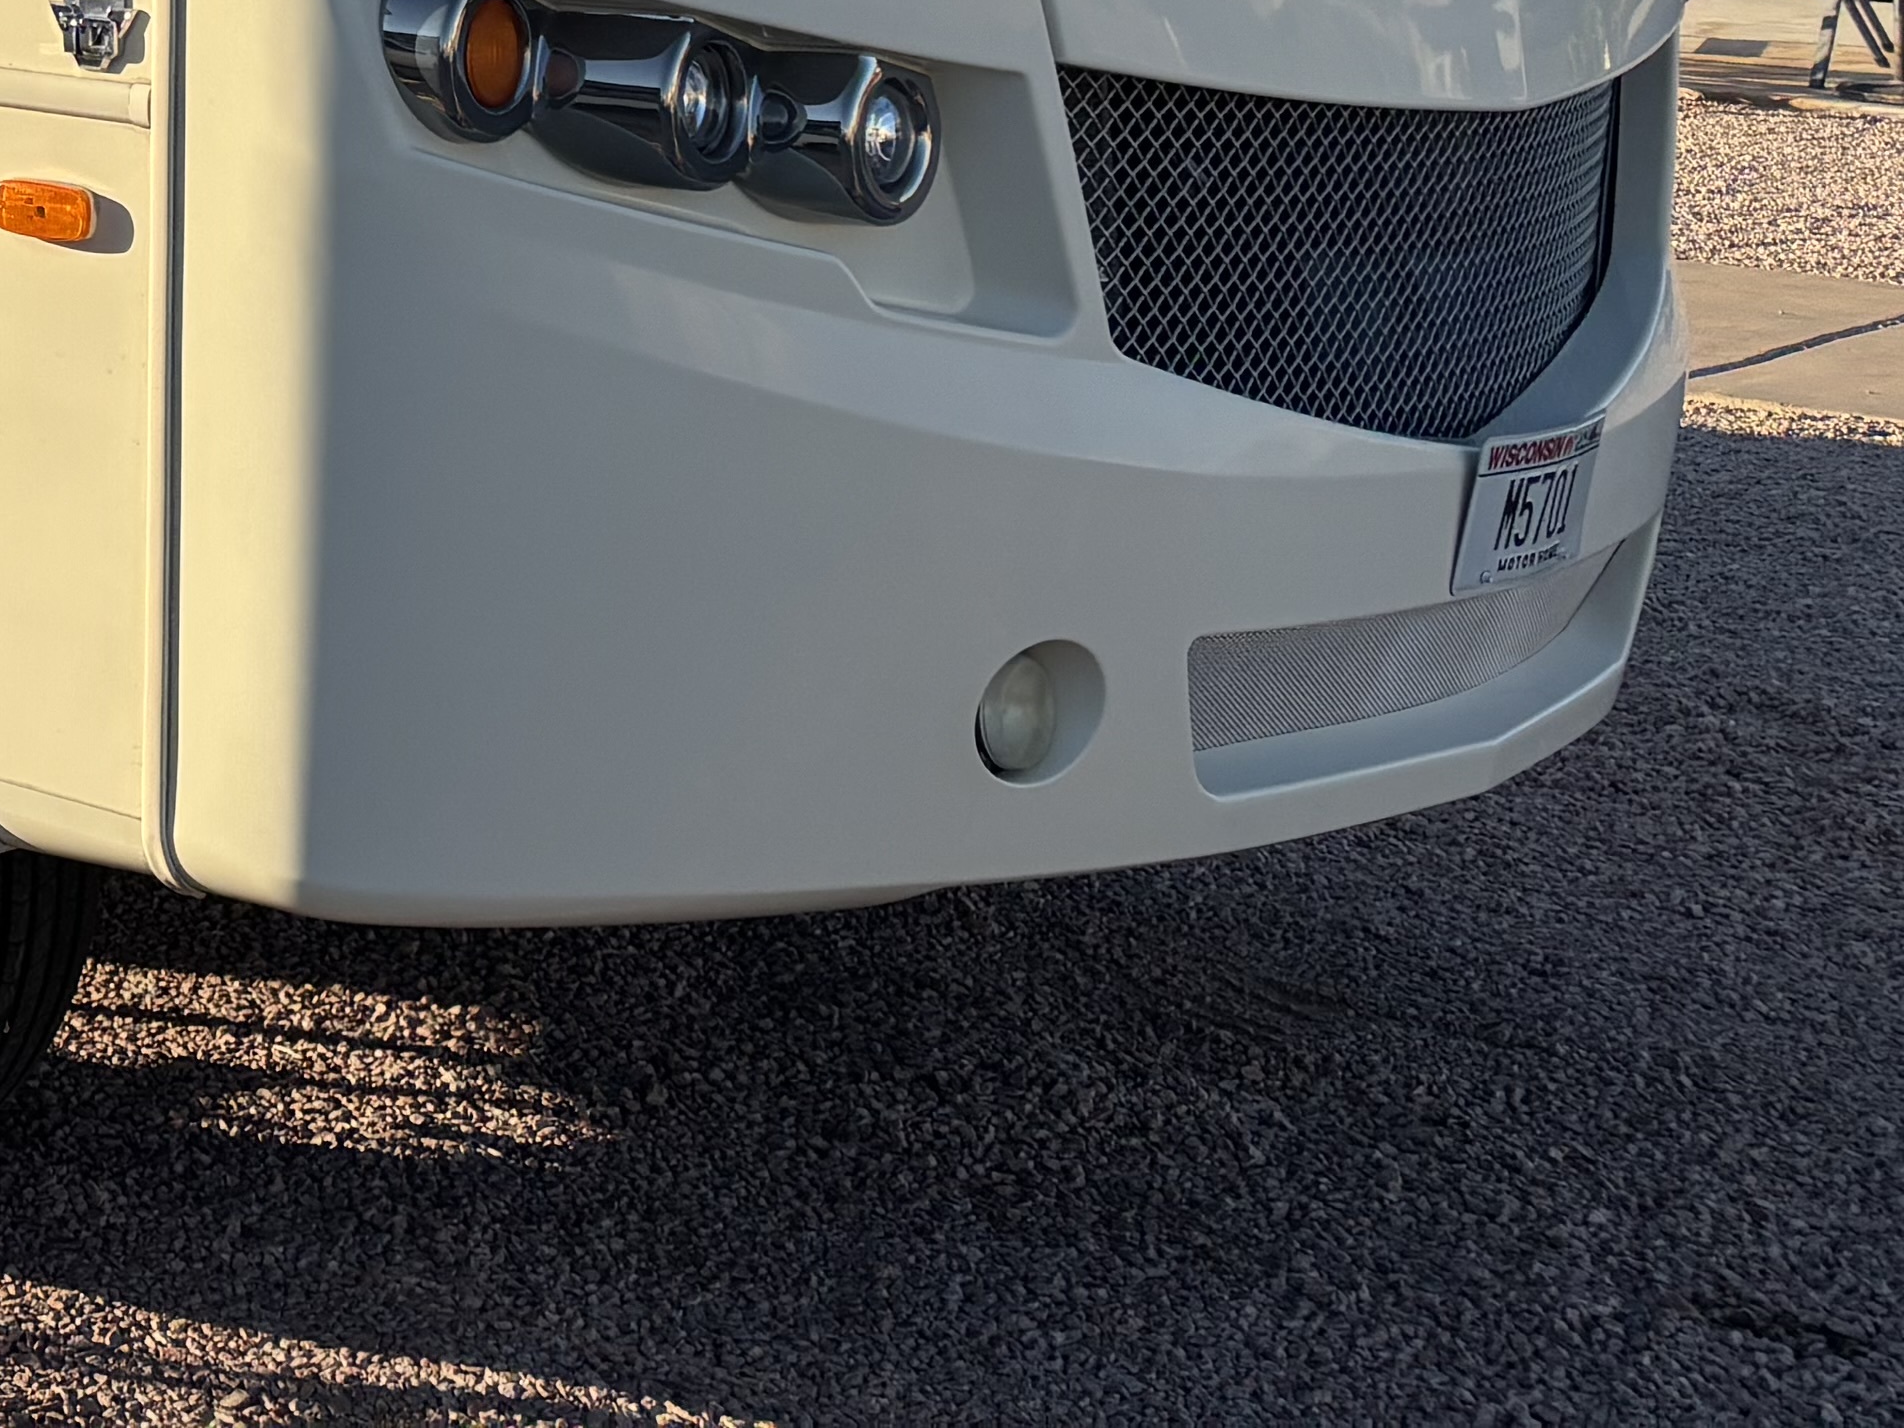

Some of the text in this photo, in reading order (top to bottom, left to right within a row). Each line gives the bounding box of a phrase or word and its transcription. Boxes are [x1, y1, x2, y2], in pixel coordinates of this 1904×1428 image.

[1489, 434, 1574, 469] WISCONSIN
[1494, 463, 1579, 551] M5701
[1497, 553, 1535, 572] MOTOR
